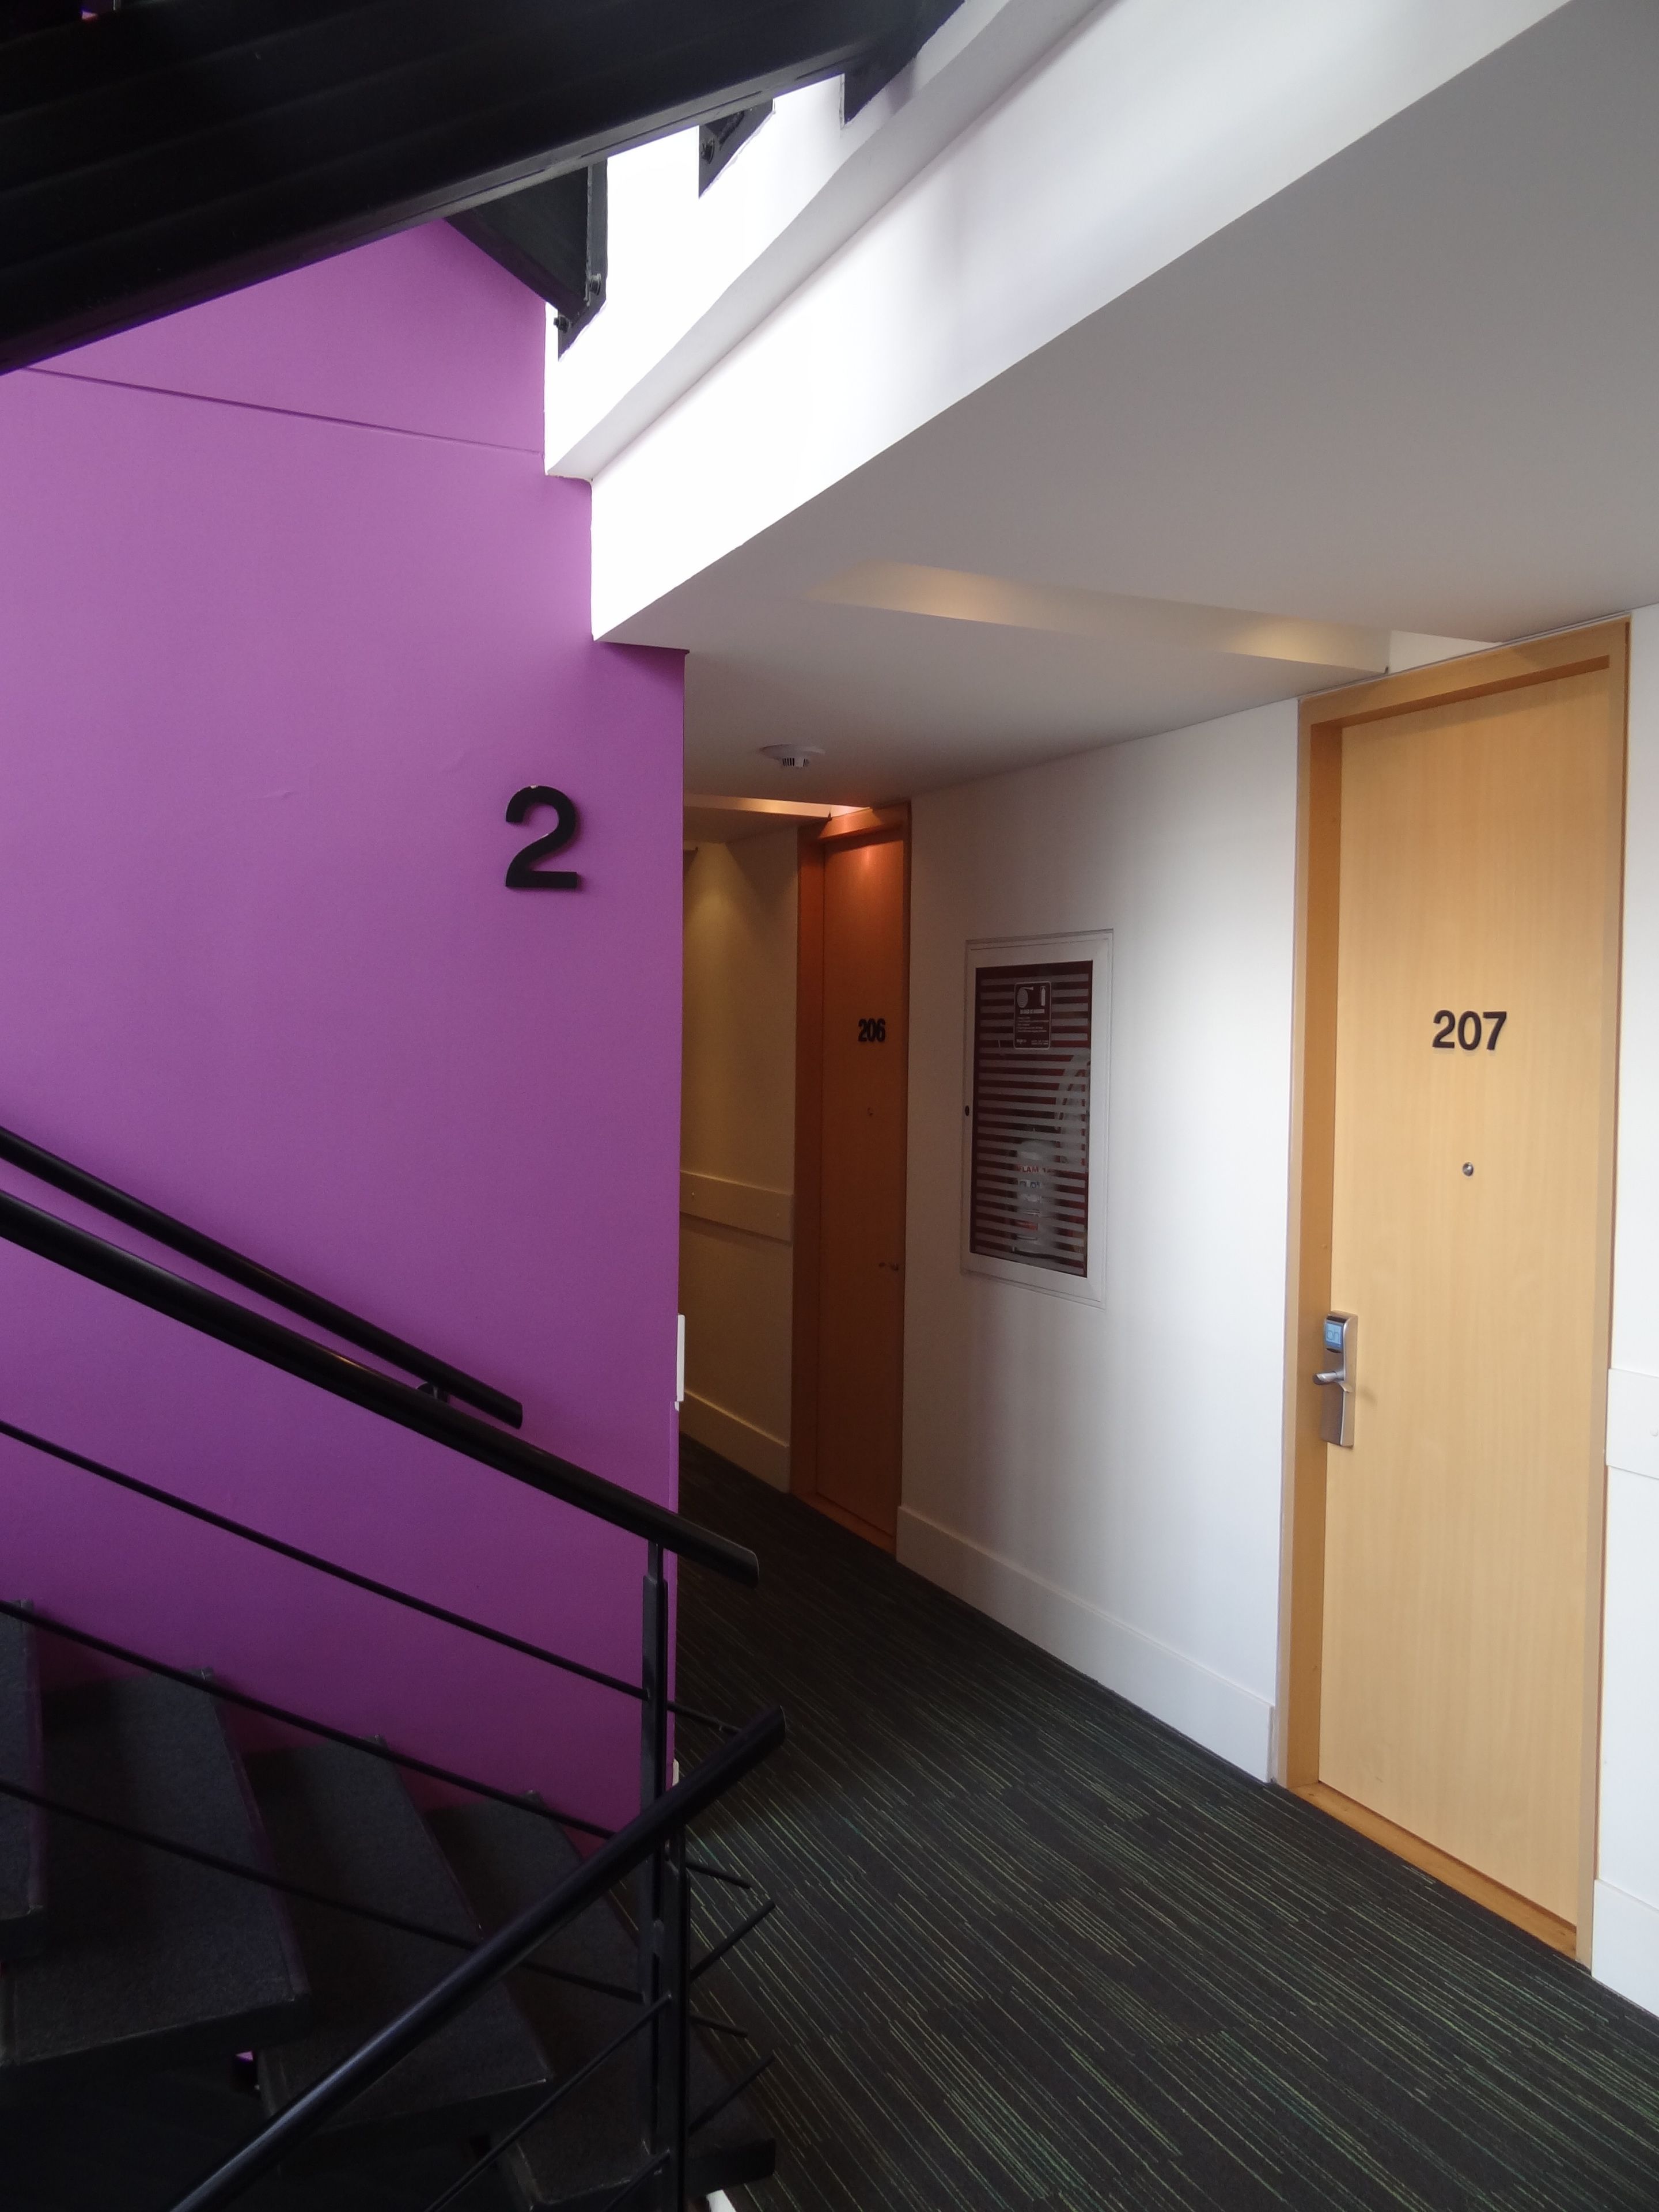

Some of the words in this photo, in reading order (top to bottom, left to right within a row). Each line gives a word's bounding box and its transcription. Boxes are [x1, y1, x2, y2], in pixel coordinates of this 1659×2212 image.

[505, 786, 577, 888] 2
[858, 1018, 886, 1042] 206
[1432, 1009, 1507, 1050] 207
